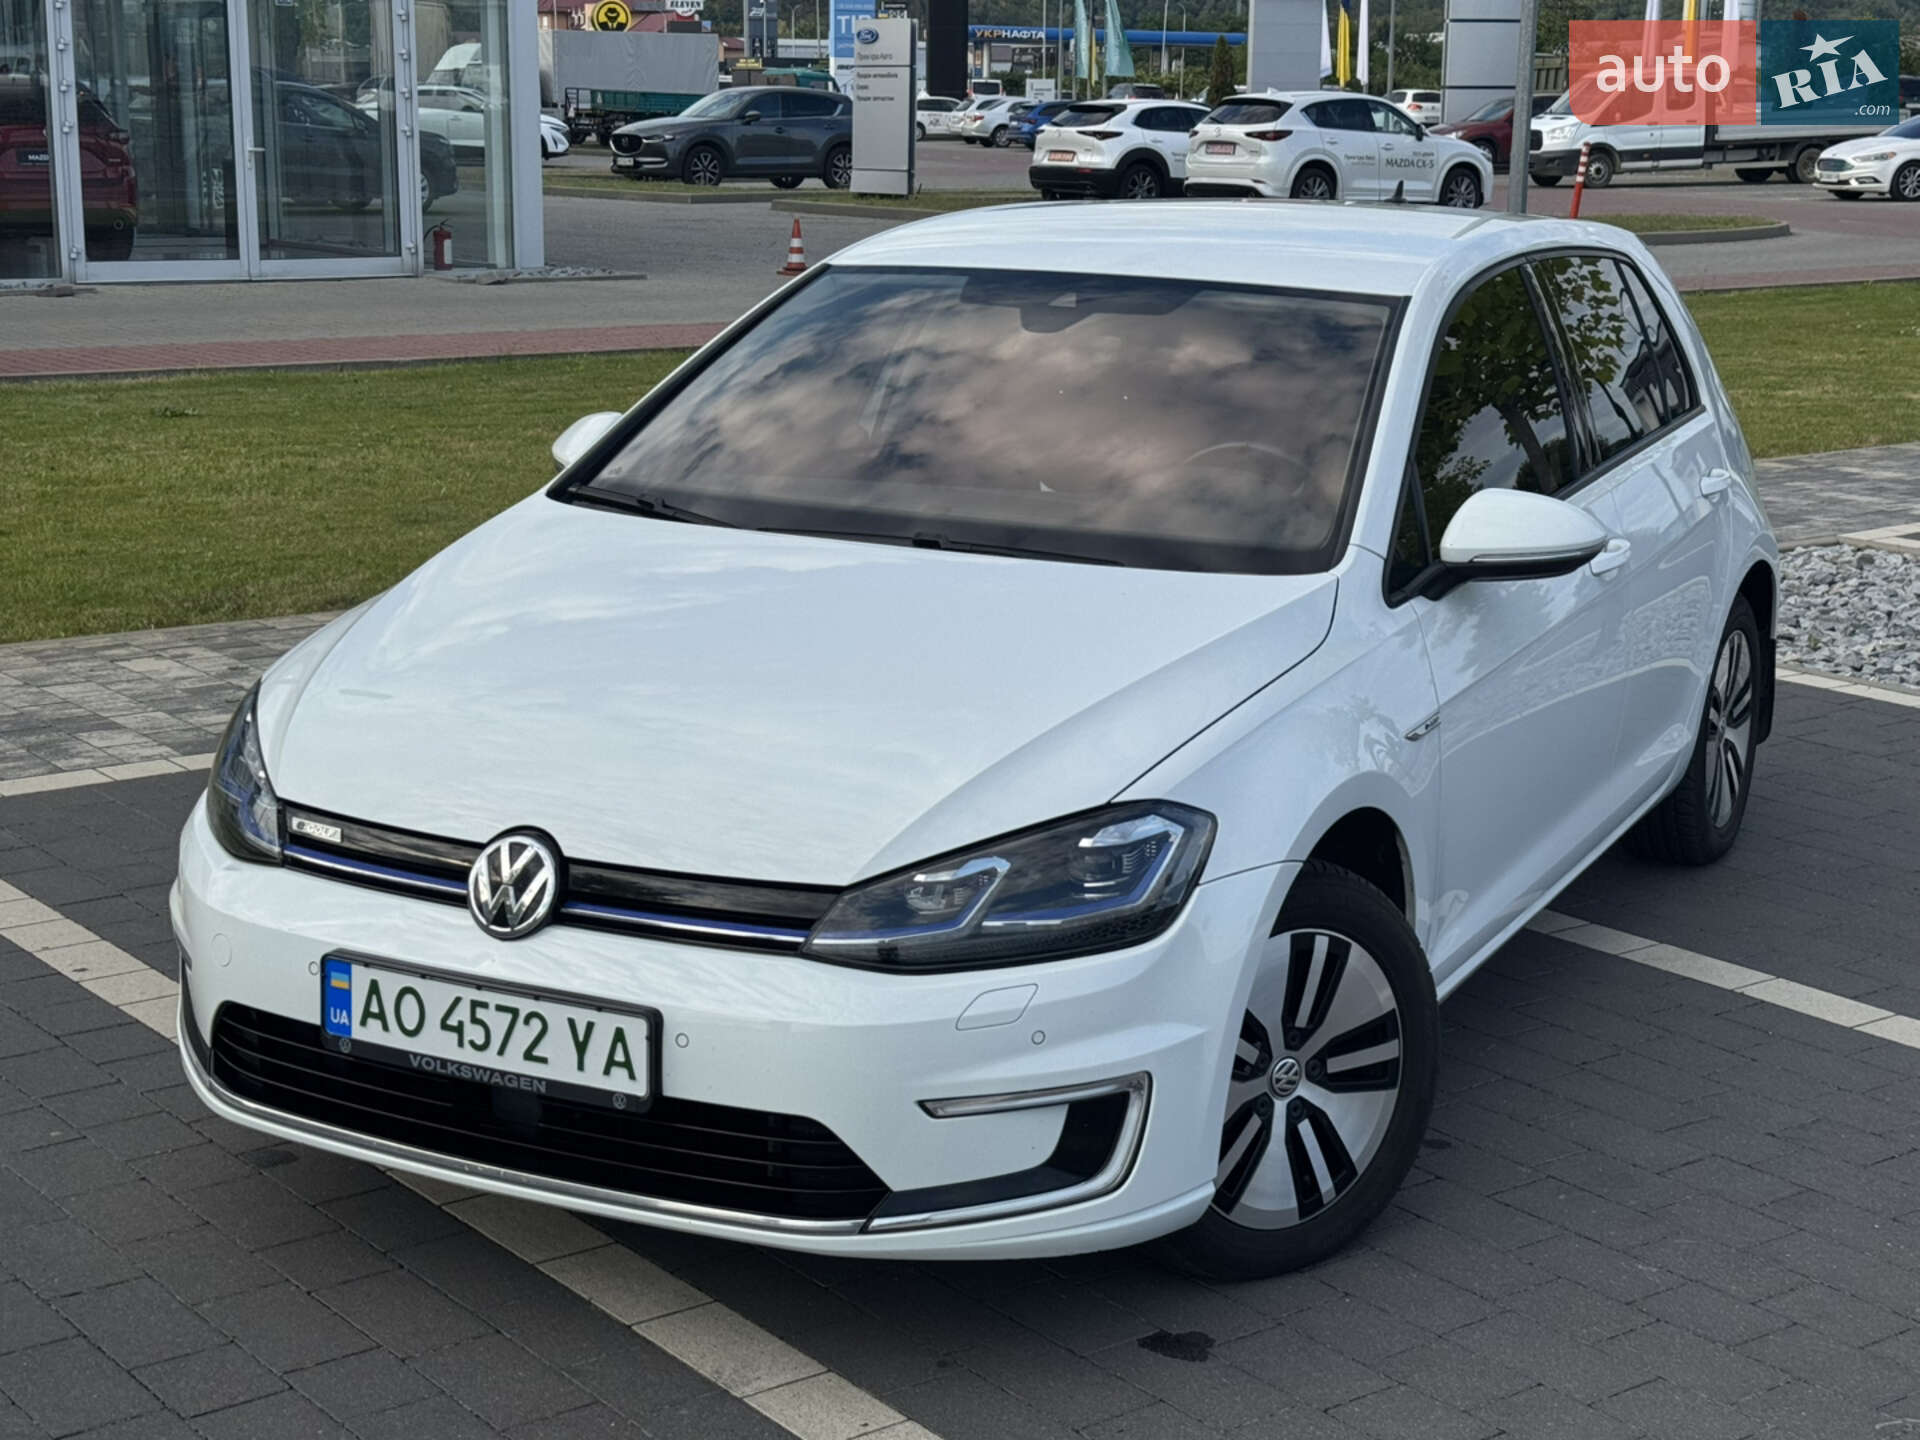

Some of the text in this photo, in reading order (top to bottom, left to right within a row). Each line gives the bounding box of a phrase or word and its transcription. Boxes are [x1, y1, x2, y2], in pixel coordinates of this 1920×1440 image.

[975, 29, 1046, 39] УКРНАФТА
[330, 1007, 349, 1026] UA
[359, 978, 637, 1081] AO 4572 YA
[409, 1053, 547, 1093] VOLKSWAGEN
